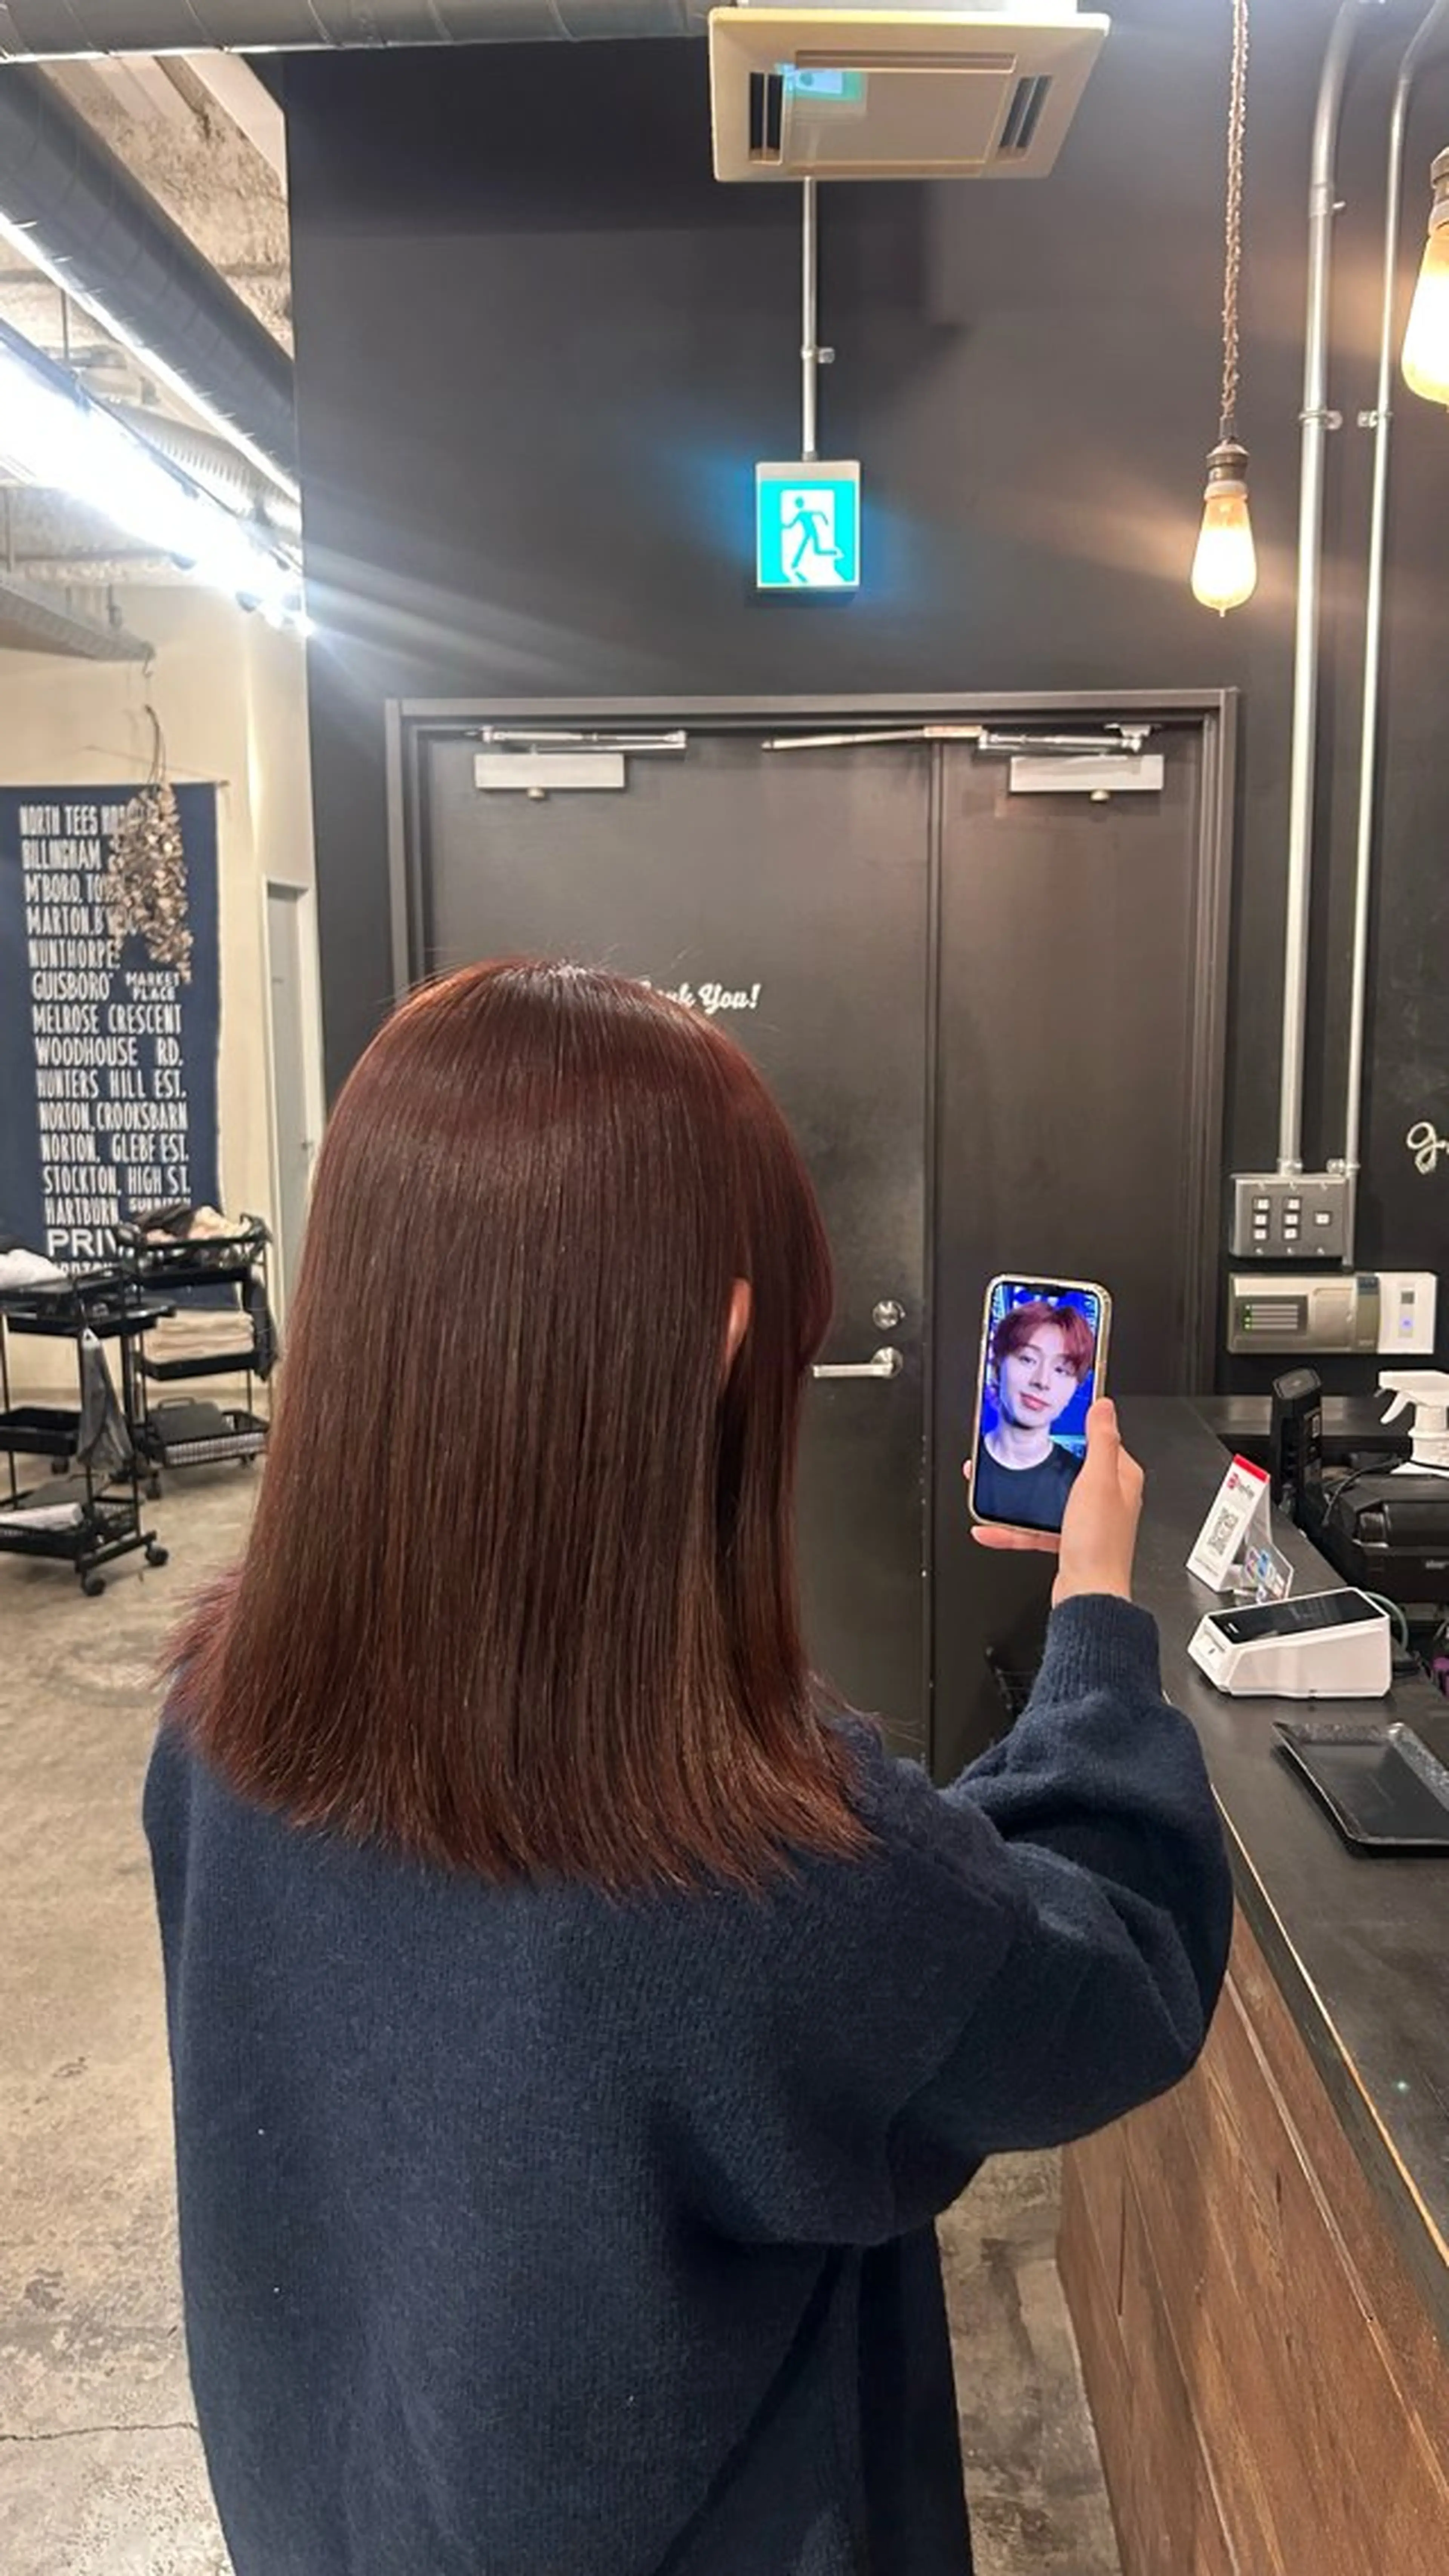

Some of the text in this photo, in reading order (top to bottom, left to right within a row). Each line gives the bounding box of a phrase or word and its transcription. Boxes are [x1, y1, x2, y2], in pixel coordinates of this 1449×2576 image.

[20, 805, 60, 836] NORTH
[65, 805, 98, 836] TEES
[22, 839, 101, 870] BILLINGHAM
[126, 971, 179, 987] MARKET
[133, 986, 175, 1002] PLACE
[698, 982, 761, 1015] You!
[33, 1004, 182, 1034] MELROSE CRESCENT
[35, 1037, 184, 1066] WOODHOUSE RD.
[36, 1069, 186, 1099] HUNTERS HILL EST.
[41, 1133, 101, 1163] NORTON.
[160, 1133, 189, 1163] EST.
[43, 1165, 191, 1195] STOCKTON. HIGH ST.
